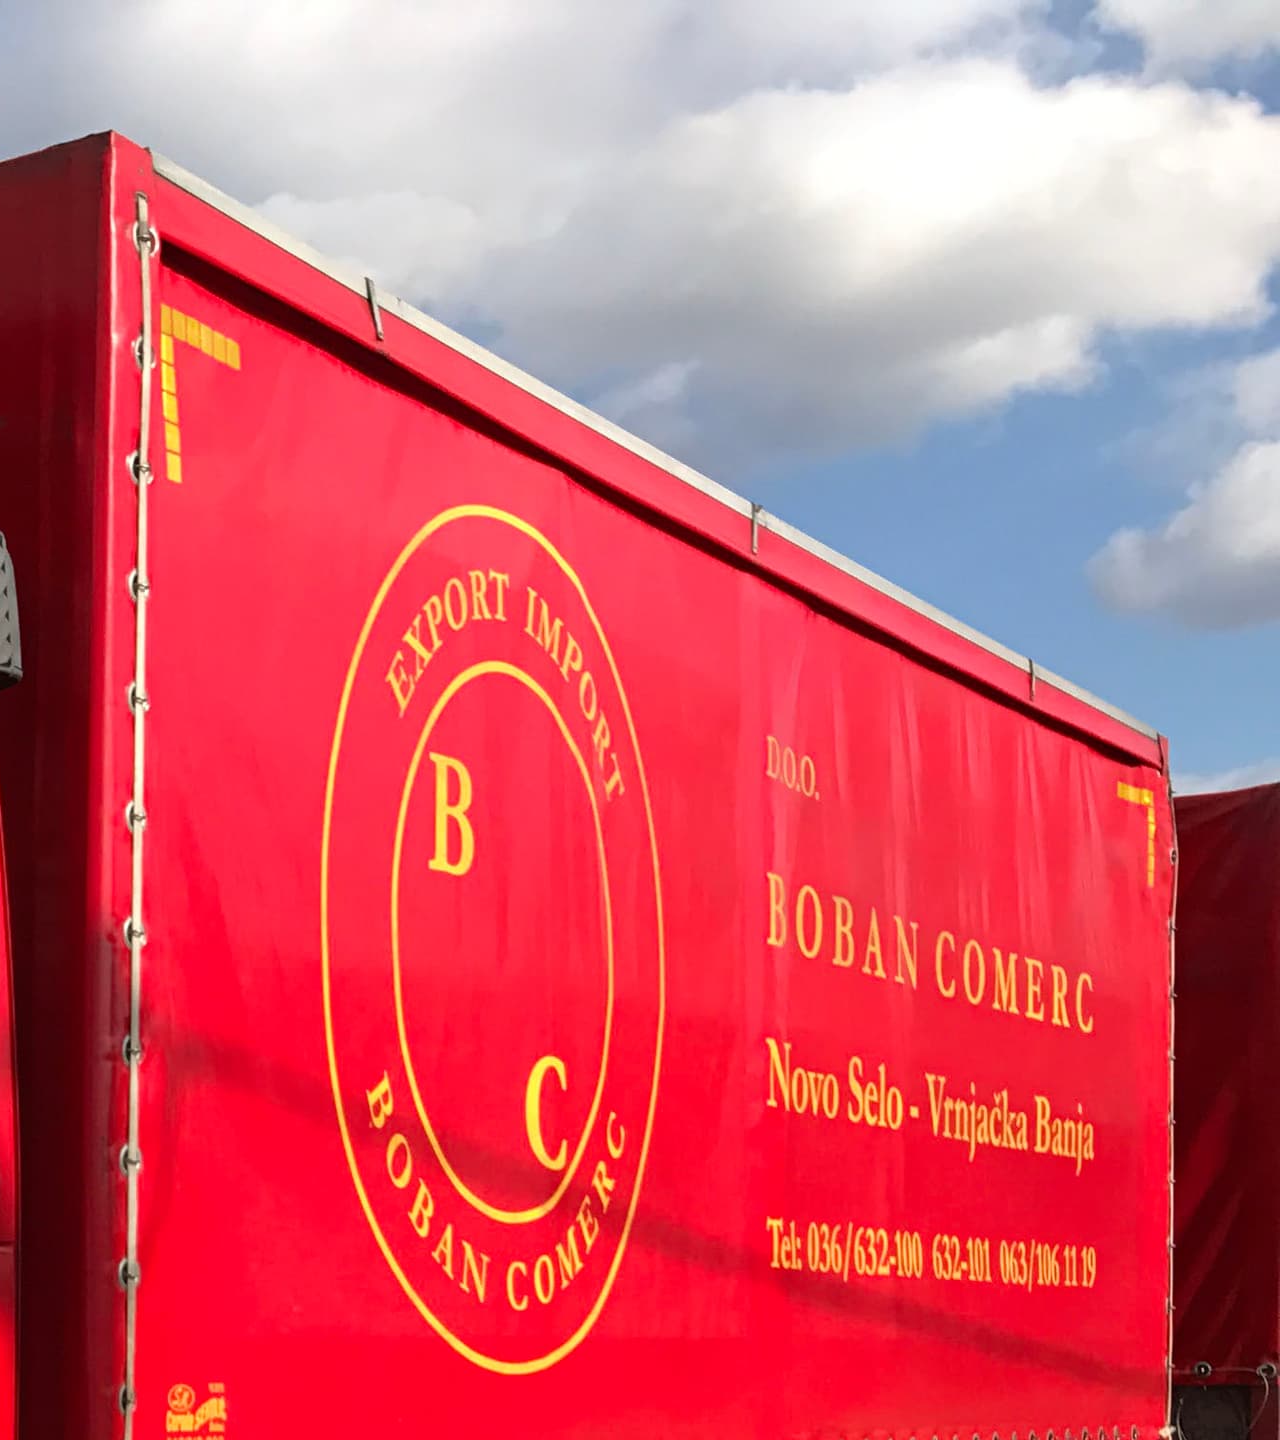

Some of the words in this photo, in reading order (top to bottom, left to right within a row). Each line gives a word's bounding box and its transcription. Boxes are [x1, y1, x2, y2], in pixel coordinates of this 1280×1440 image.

[385, 569, 510, 719] EXPORT
[524, 586, 625, 801] IMPORT
[428, 752, 474, 876] B
[766, 735, 820, 801] D.O.O.
[766, 871, 919, 990] BOBAN
[935, 930, 1094, 1033] COMERC
[525, 1055, 567, 1170] C
[766, 1037, 839, 1120] Novo
[847, 1055, 904, 1130] Selo
[925, 1071, 1029, 1163] Vrnjačka
[1034, 1094, 1095, 1177] Banja
[366, 1070, 491, 1304] BOBAN
[506, 1111, 626, 1311] COMERC
[766, 1216, 803, 1271] Tel:
[807, 1220, 923, 1283] 036/632-100
[932, 1233, 992, 1283] 632-101
